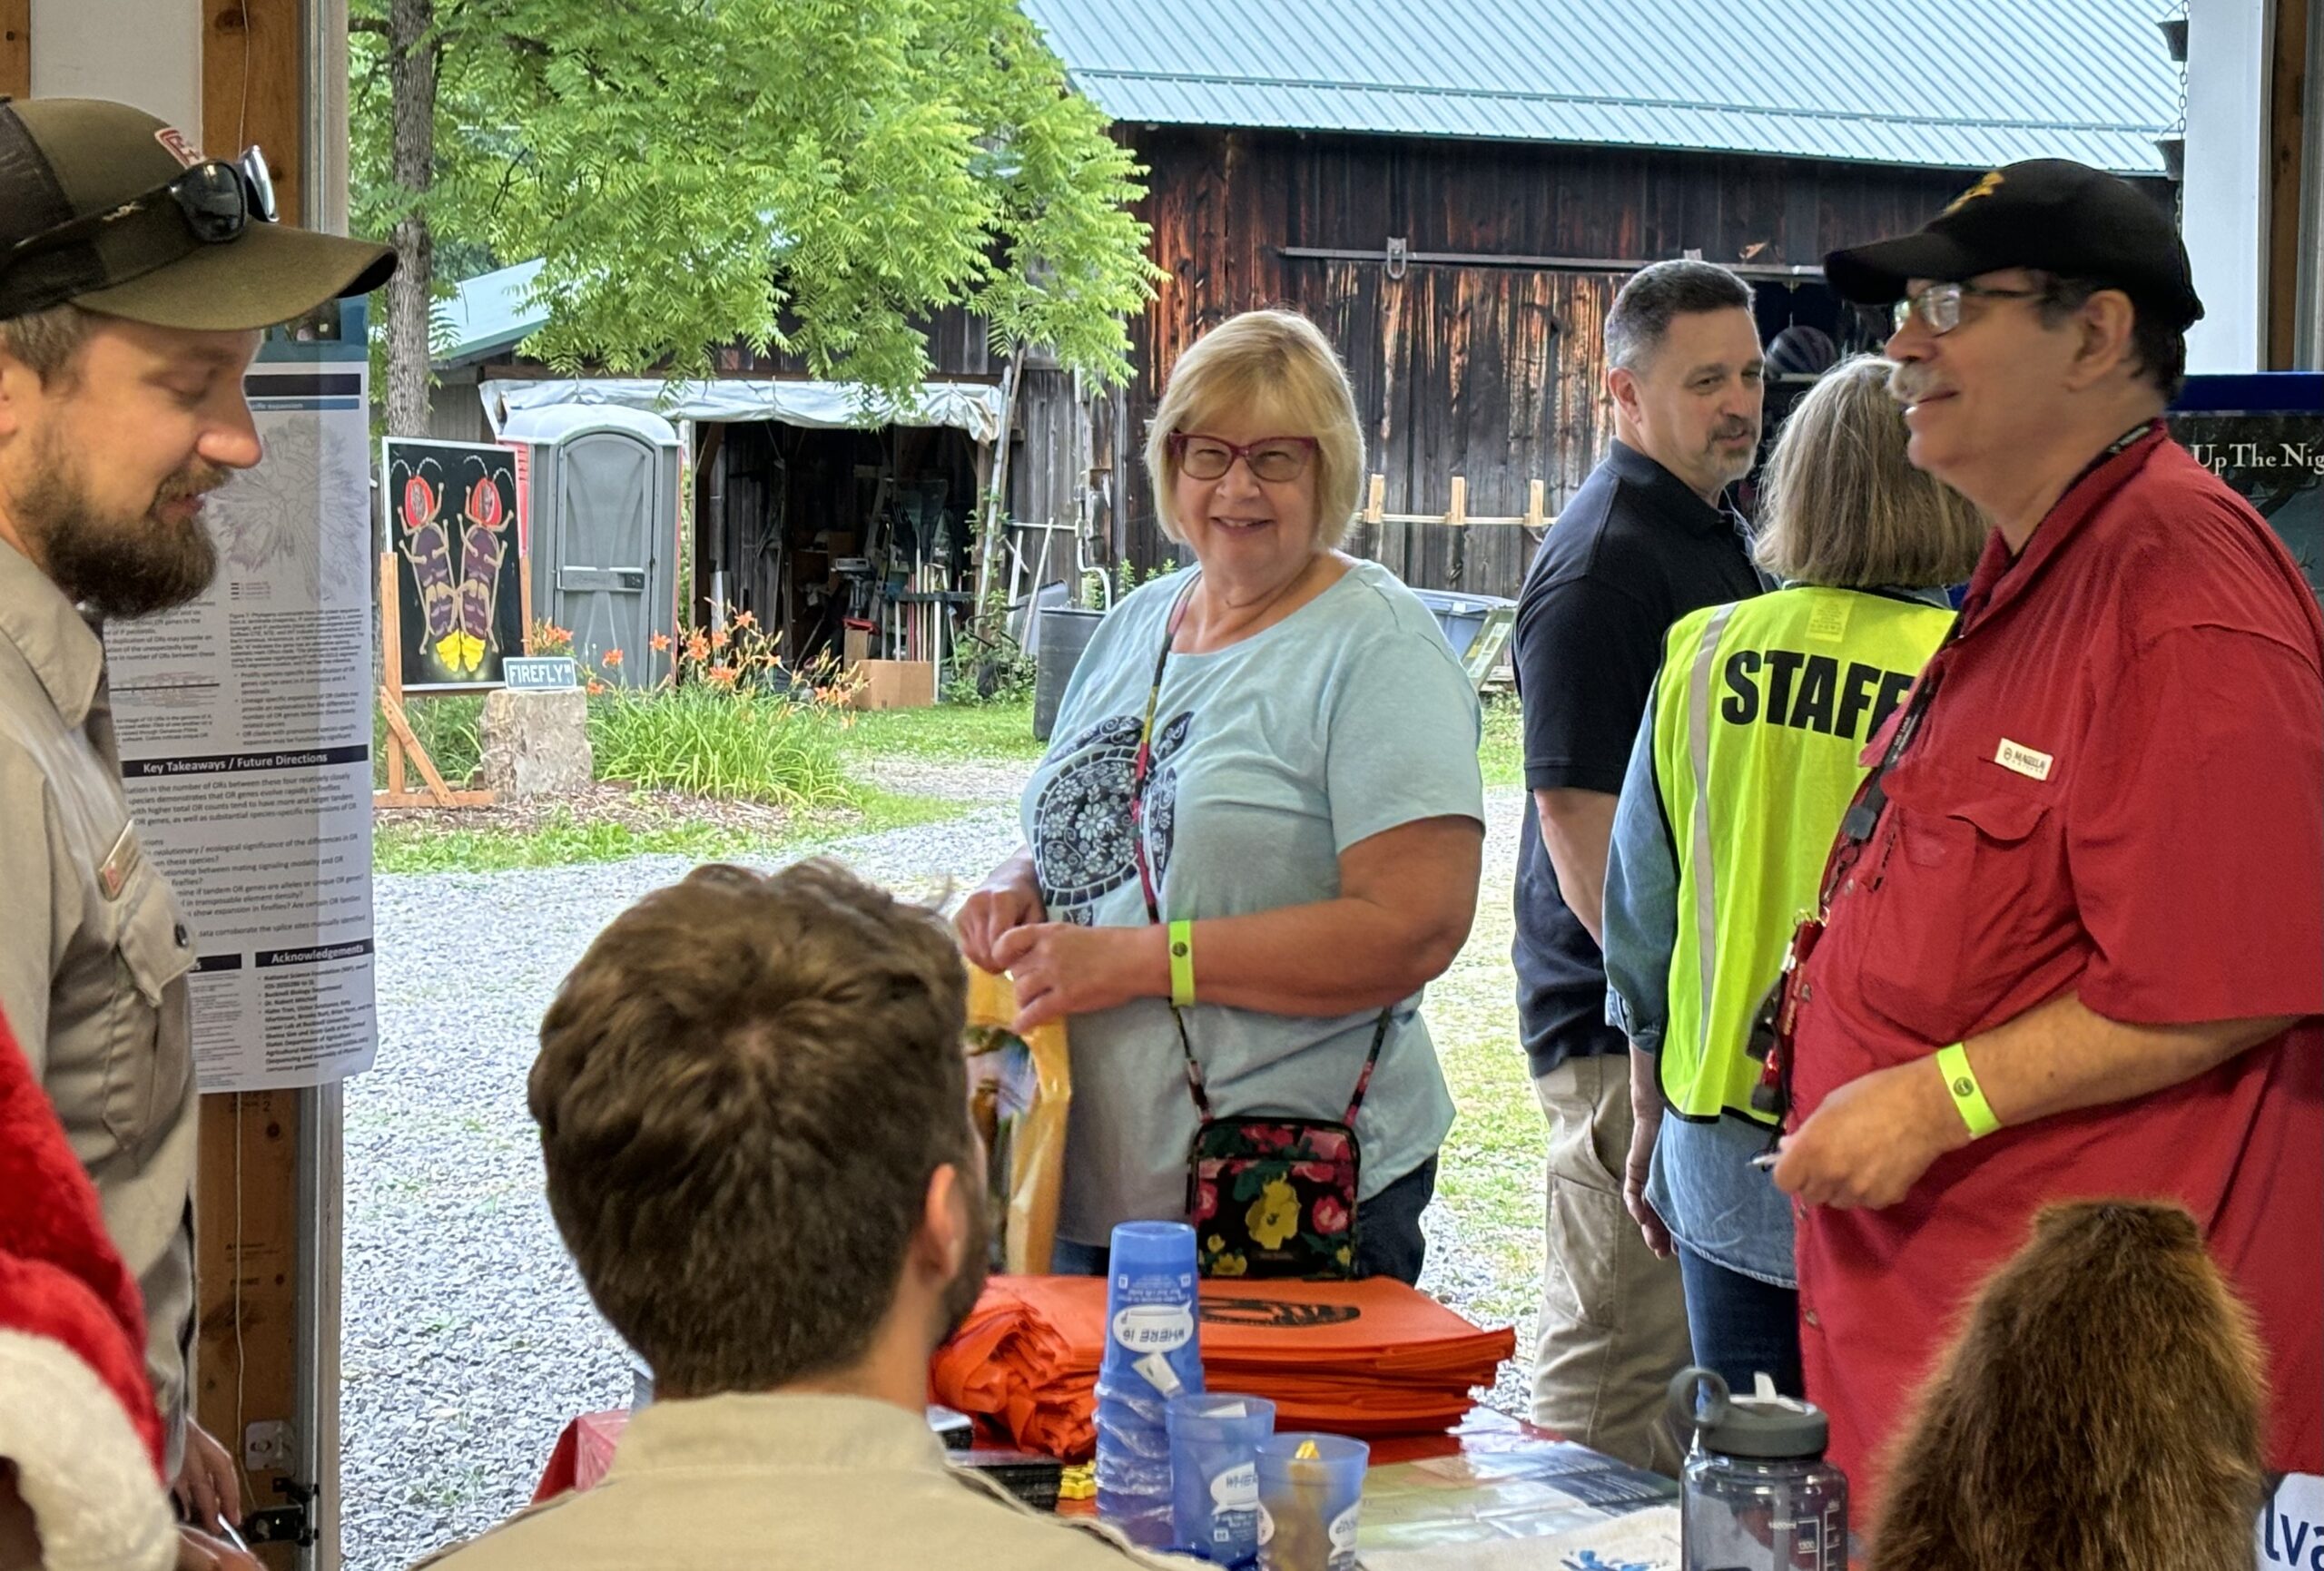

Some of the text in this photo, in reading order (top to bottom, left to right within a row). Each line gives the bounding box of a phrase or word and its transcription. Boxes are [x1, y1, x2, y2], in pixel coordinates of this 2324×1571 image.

[2190, 444, 2227, 476] Up
[2229, 443, 2277, 467] The
[508, 664, 572, 685] FIREFLY
[1722, 651, 1915, 743] STAFF
[143, 754, 328, 774] Key Takeaways / Future Directions
[271, 944, 364, 963] Acknowledgements
